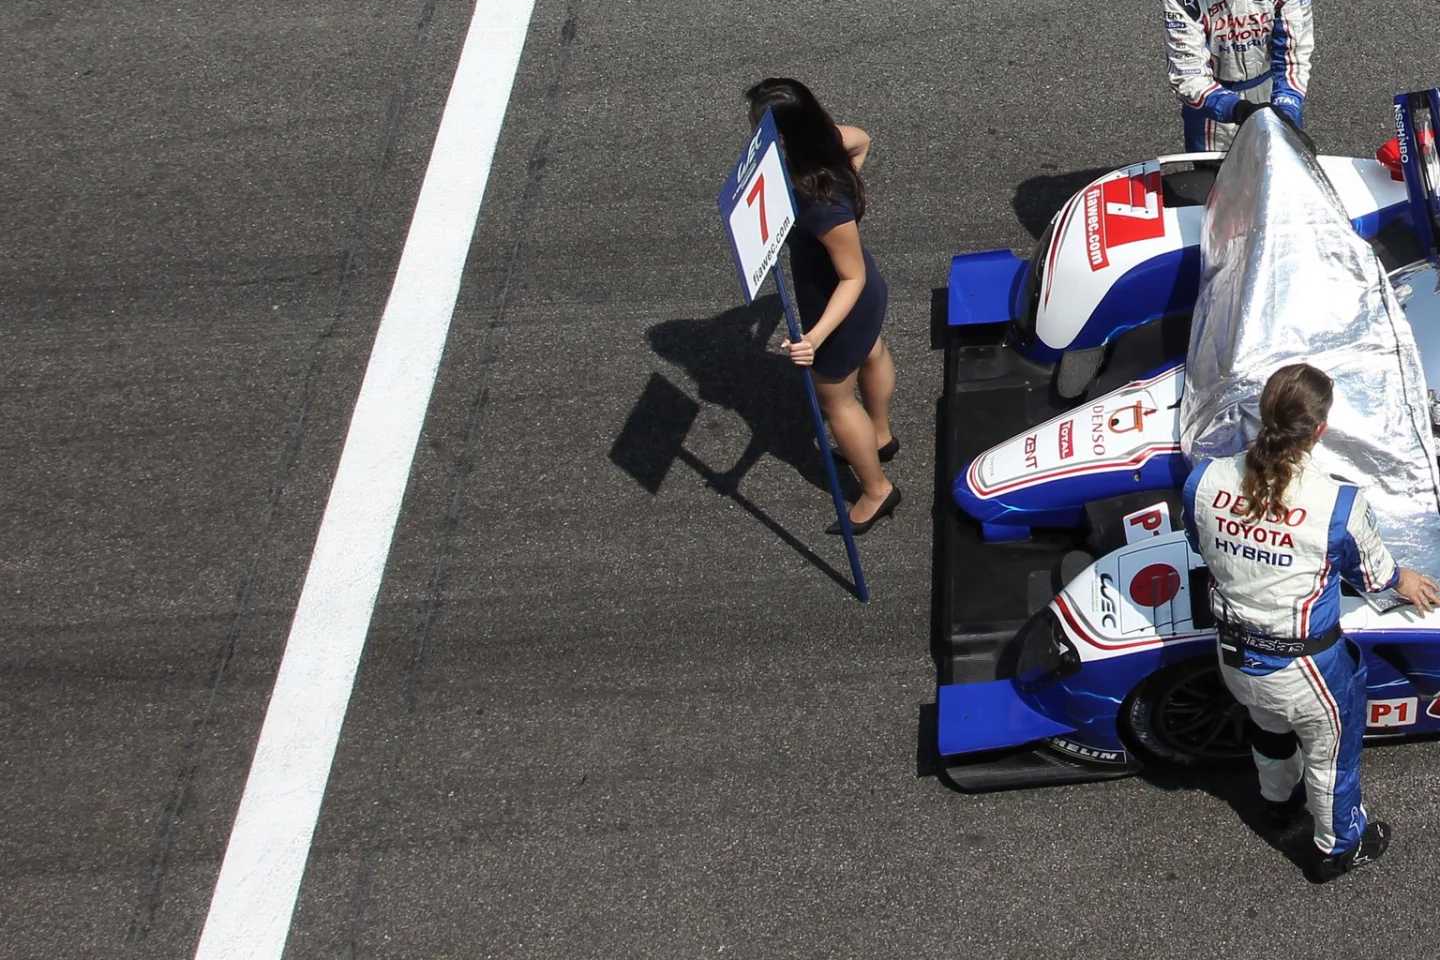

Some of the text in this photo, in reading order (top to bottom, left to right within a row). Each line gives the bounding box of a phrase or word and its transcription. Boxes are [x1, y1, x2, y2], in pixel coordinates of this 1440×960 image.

[1216, 26, 1271, 43] TOYOTA
[746, 172, 769, 247] 7
[1106, 191, 1160, 220] 7
[1085, 189, 1103, 266] fiawec.com
[752, 216, 792, 287] fiawec.com
[1059, 421, 1073, 459] TOTAL
[1091, 404, 1106, 456] DENSO
[1024, 434, 1038, 469] ZENT
[1215, 516, 1295, 549] TOYOTA
[1215, 537, 1293, 568] HYBRID
[1100, 572, 1118, 629] WEC
[1370, 702, 1409, 724] P1
[1052, 737, 1118, 760] HELIN
